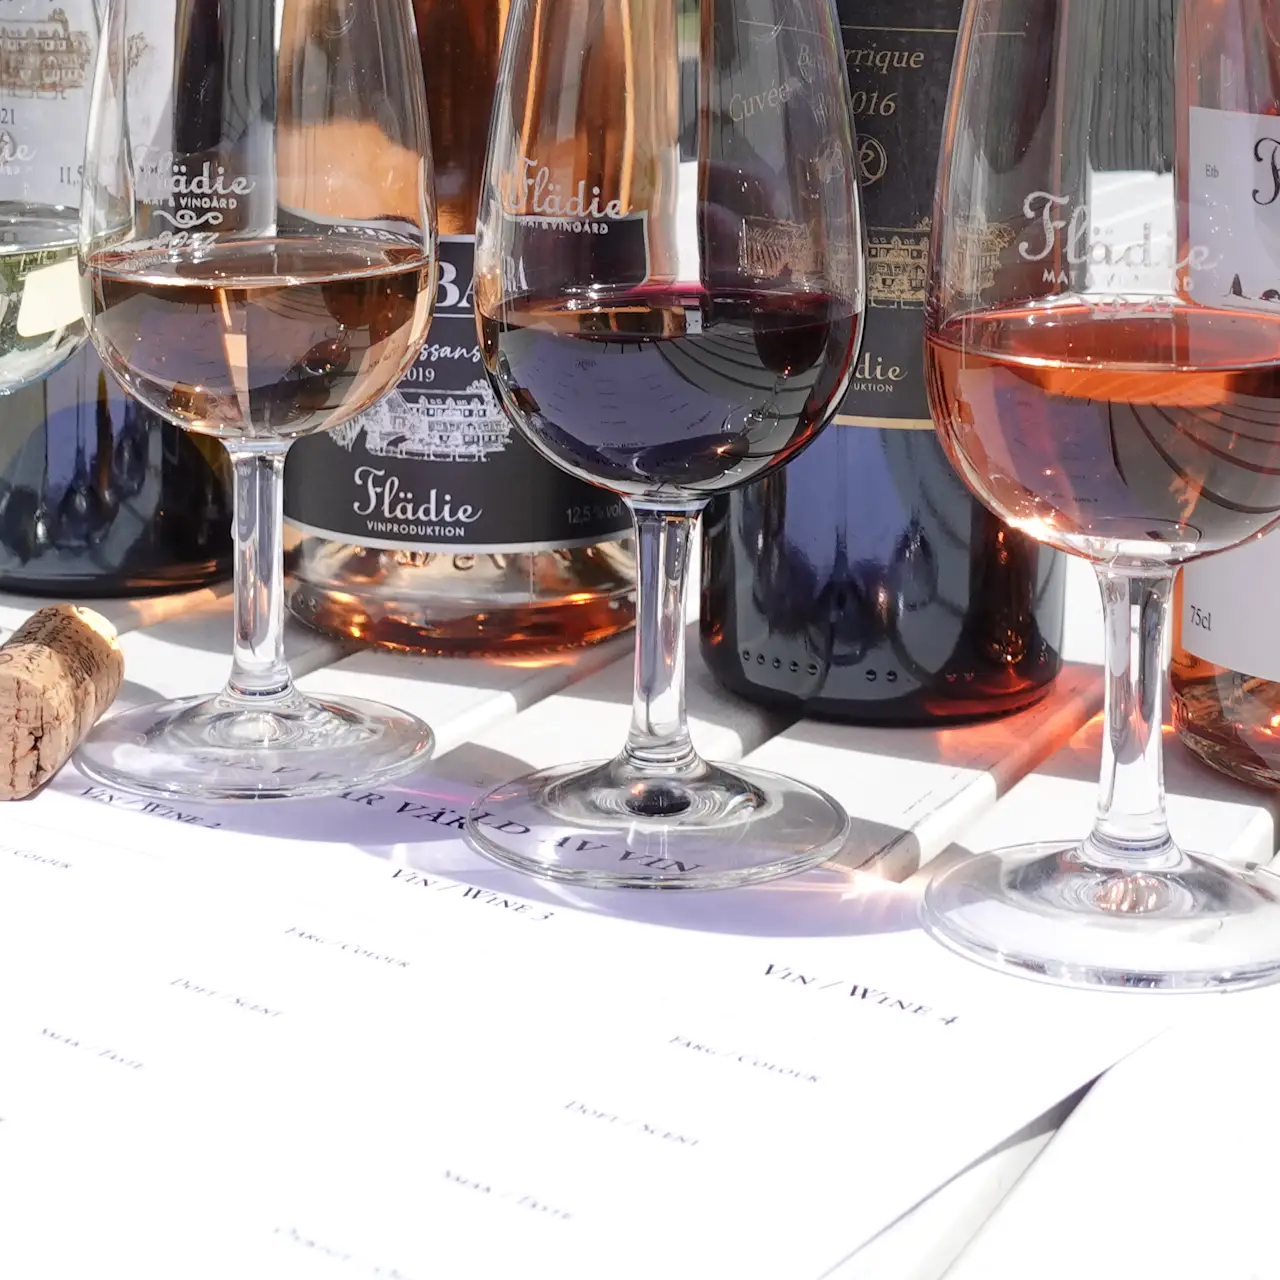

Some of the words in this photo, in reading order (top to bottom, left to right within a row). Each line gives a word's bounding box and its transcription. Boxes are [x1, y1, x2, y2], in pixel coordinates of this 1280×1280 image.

[509, 157, 634, 219] Flädie
[352, 465, 483, 523] Flädie
[366, 520, 466, 538] VINPRODUKTION
[1190, 605, 1212, 632] 75cl
[764, 963, 817, 986] VIN
[849, 984, 933, 1016] WINE
